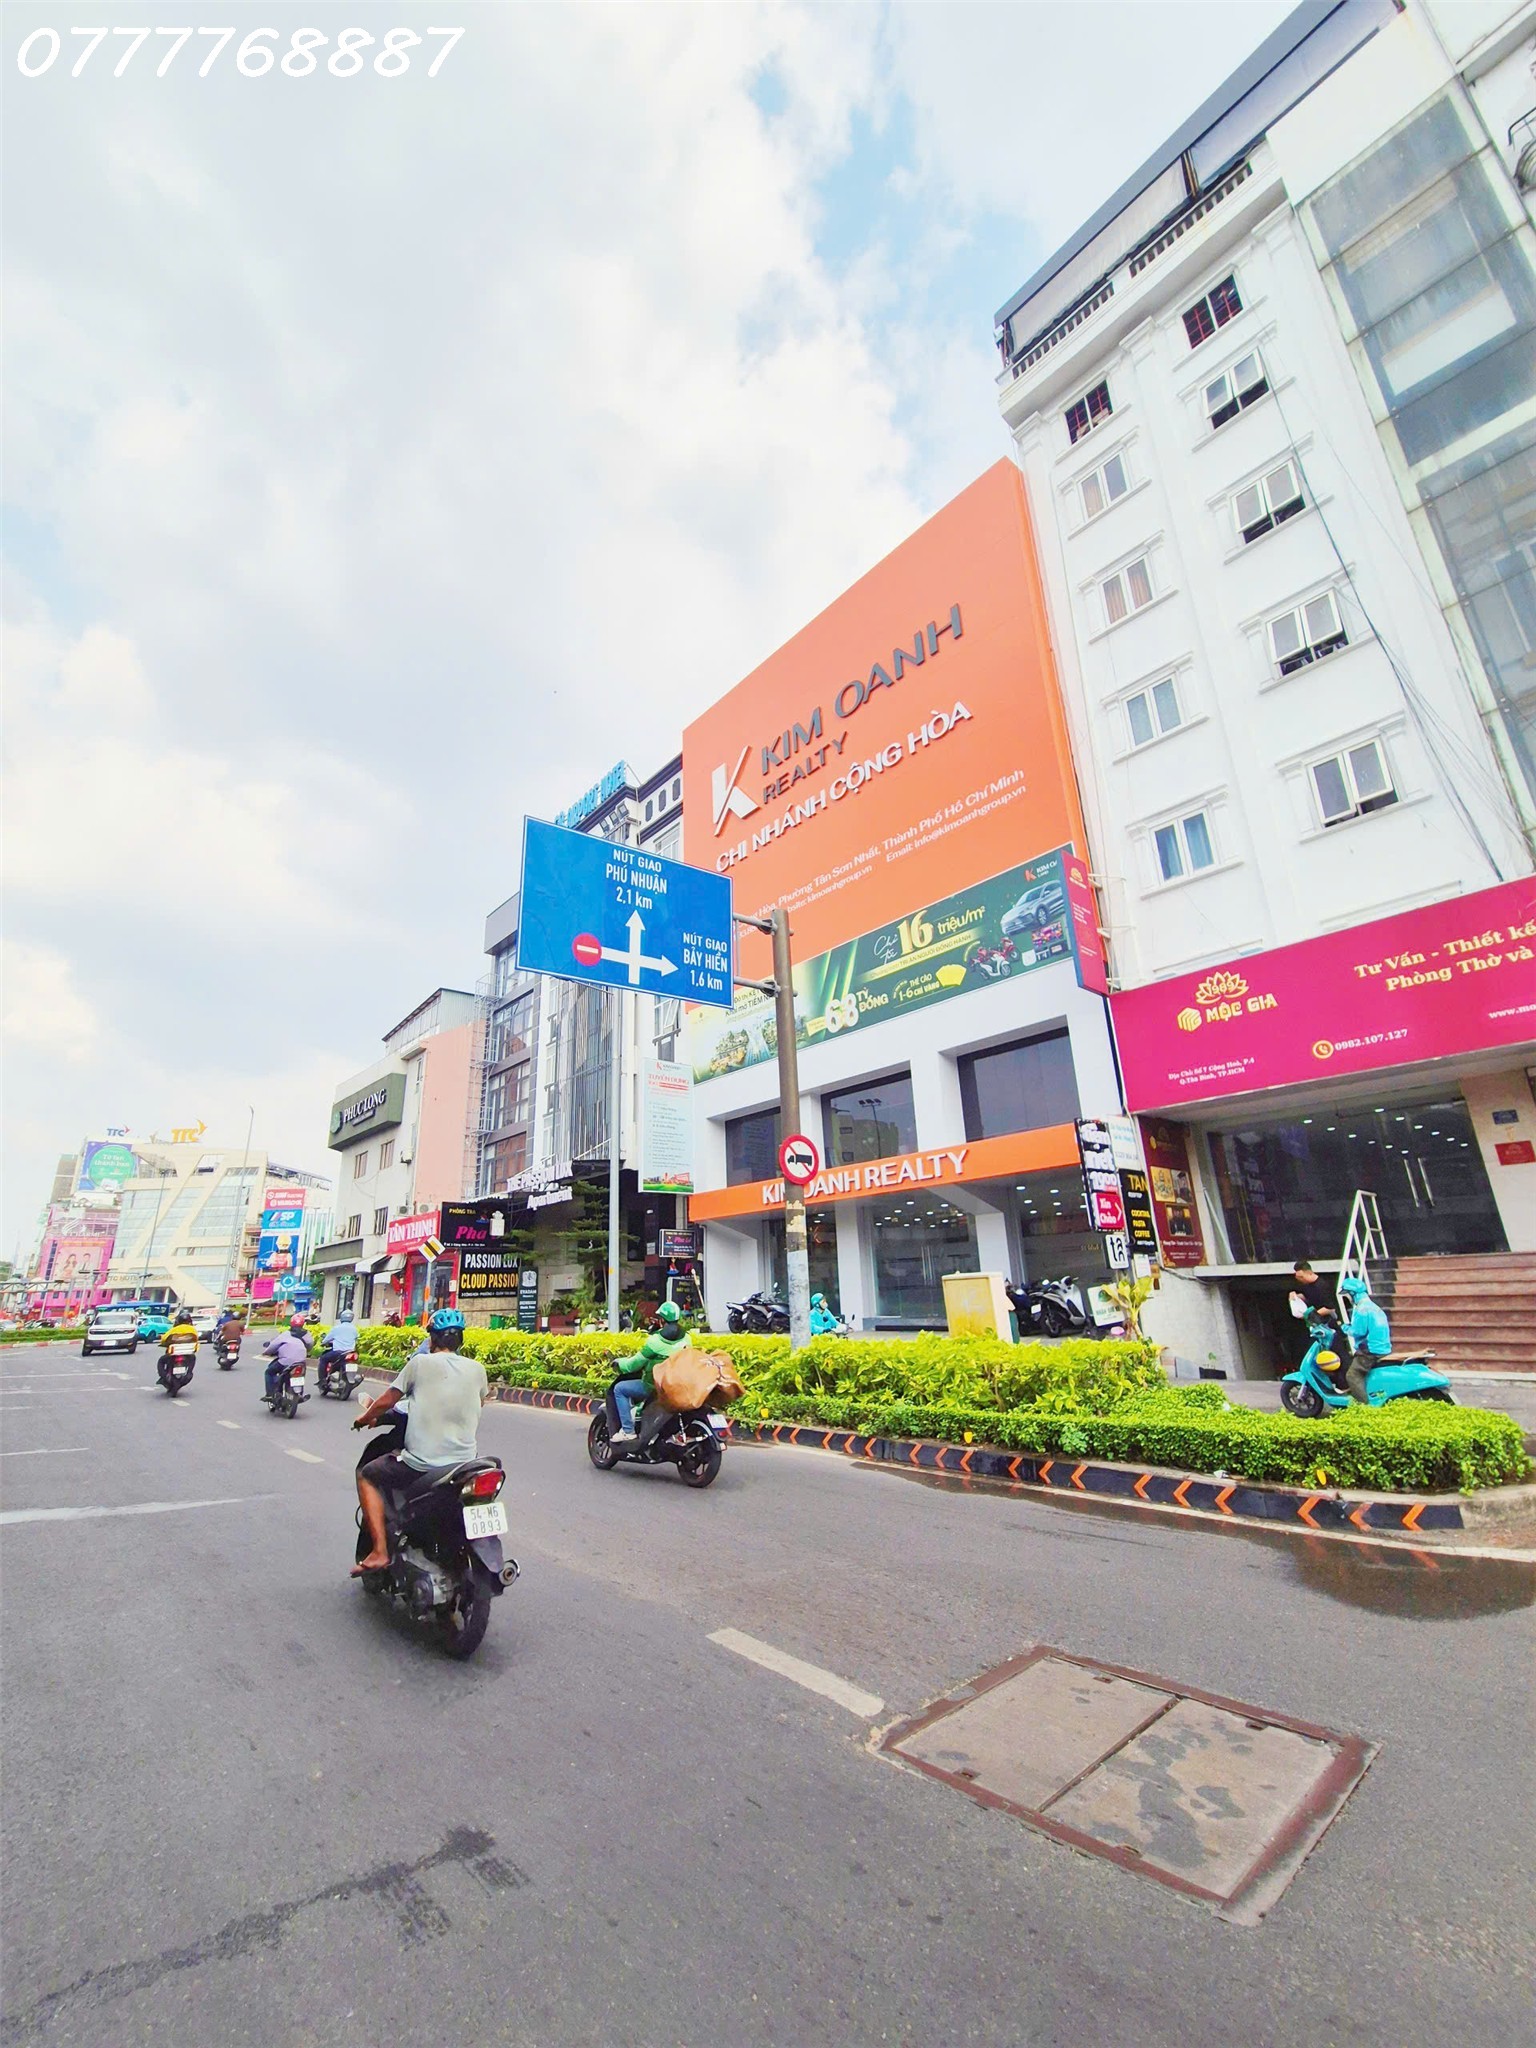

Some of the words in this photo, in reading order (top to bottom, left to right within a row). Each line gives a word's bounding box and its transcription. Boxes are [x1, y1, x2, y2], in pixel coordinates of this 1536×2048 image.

[760, 705, 823, 775] KIM
[833, 602, 964, 719] OANH
[762, 731, 848, 804] REALTY
[715, 841, 748, 872] CHI
[751, 789, 828, 852] NHÁNH
[829, 741, 903, 795] CỘNG
[908, 700, 973, 754] HÒA
[813, 873, 832, 888] Tân
[832, 862, 853, 878] Sơn
[882, 825, 918, 851] Thành
[989, 769, 1025, 795] Minh
[613, 849, 635, 865] NÚT
[637, 856, 662, 873] GIAO
[605, 862, 628, 884] PHÚ
[630, 870, 668, 895] NHUẬN
[635, 891, 653, 910] km
[683, 932, 703, 947] NÚT
[705, 938, 728, 953] GIAO
[896, 909, 936, 956] 16
[683, 947, 703, 967] BẢY
[705, 951, 728, 973] HIỀN
[1354, 962, 1382, 978] Tư
[1384, 951, 1427, 970] Vấn
[1443, 930, 1505, 956] Thiết
[1385, 966, 1453, 992] Phòng
[1456, 953, 1503, 974] Thờ
[1505, 945, 1535, 964] và
[707, 973, 723, 991] km
[1205, 1001, 1243, 1023] MỘC
[1246, 993, 1278, 1013] GIA
[1334, 1028, 1409, 1052] 0982.107.127
[364, 1088, 386, 1112] LONG
[863, 1149, 969, 1189] REALTY
[526, 1186, 573, 1211] Apartment
[1099, 1197, 1112, 1210] Xin
[389, 1222, 406, 1243] TÂN
[406, 1217, 438, 1241] THỊNH
[1099, 1211, 1117, 1225] Chào
[455, 1225, 488, 1240] Pha
[465, 1253, 501, 1269] PASSION
[461, 1273, 486, 1289] CLOUD
[472, 1519, 501, 1535] 0893
